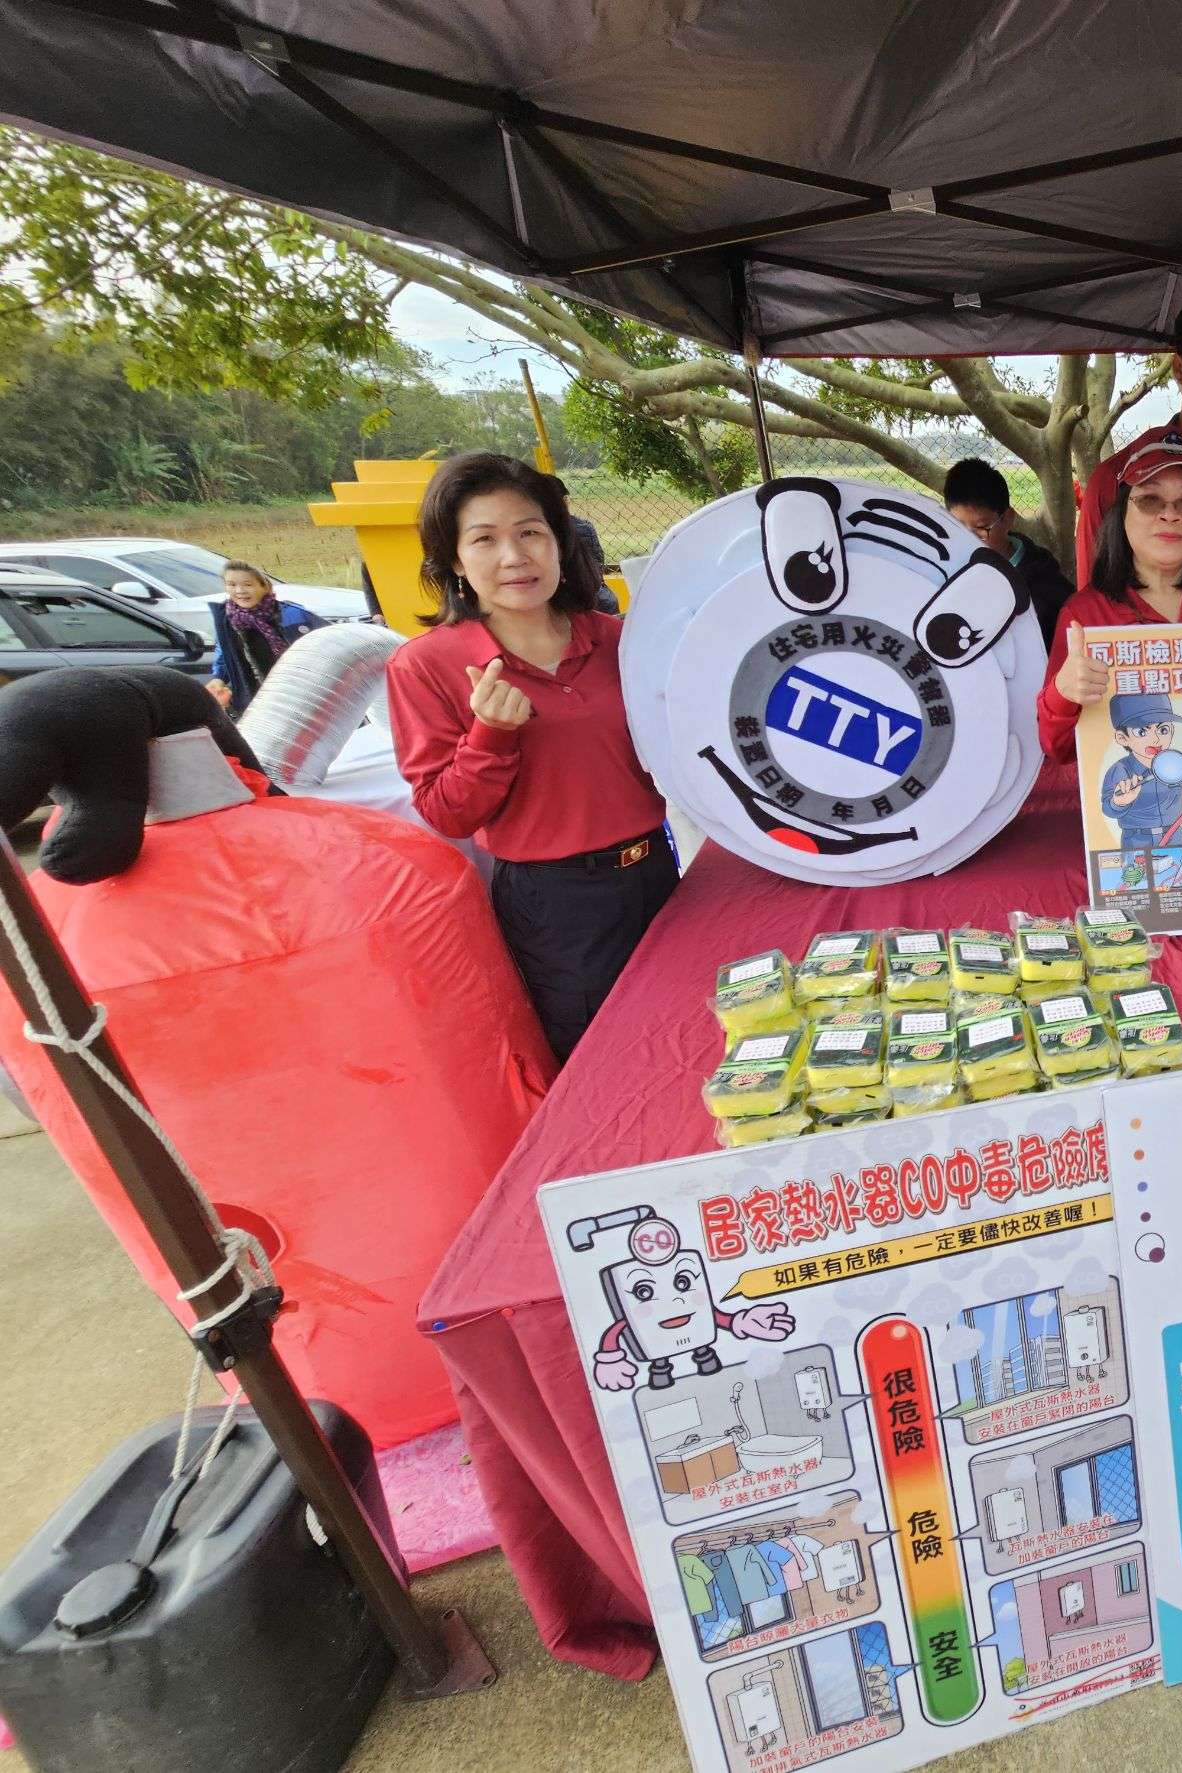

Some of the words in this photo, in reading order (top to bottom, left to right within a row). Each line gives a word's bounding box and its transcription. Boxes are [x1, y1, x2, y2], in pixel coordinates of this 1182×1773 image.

[786, 676, 916, 766] TTY
[883, 1367, 925, 1457] 很危險
[990, 1383, 1100, 1422] 屋外式瓦斯熱水器
[691, 1457, 818, 1501] 屋外式瓦斯熱水器
[907, 1509, 944, 1565] 危險
[928, 1630, 964, 1682] 安全
